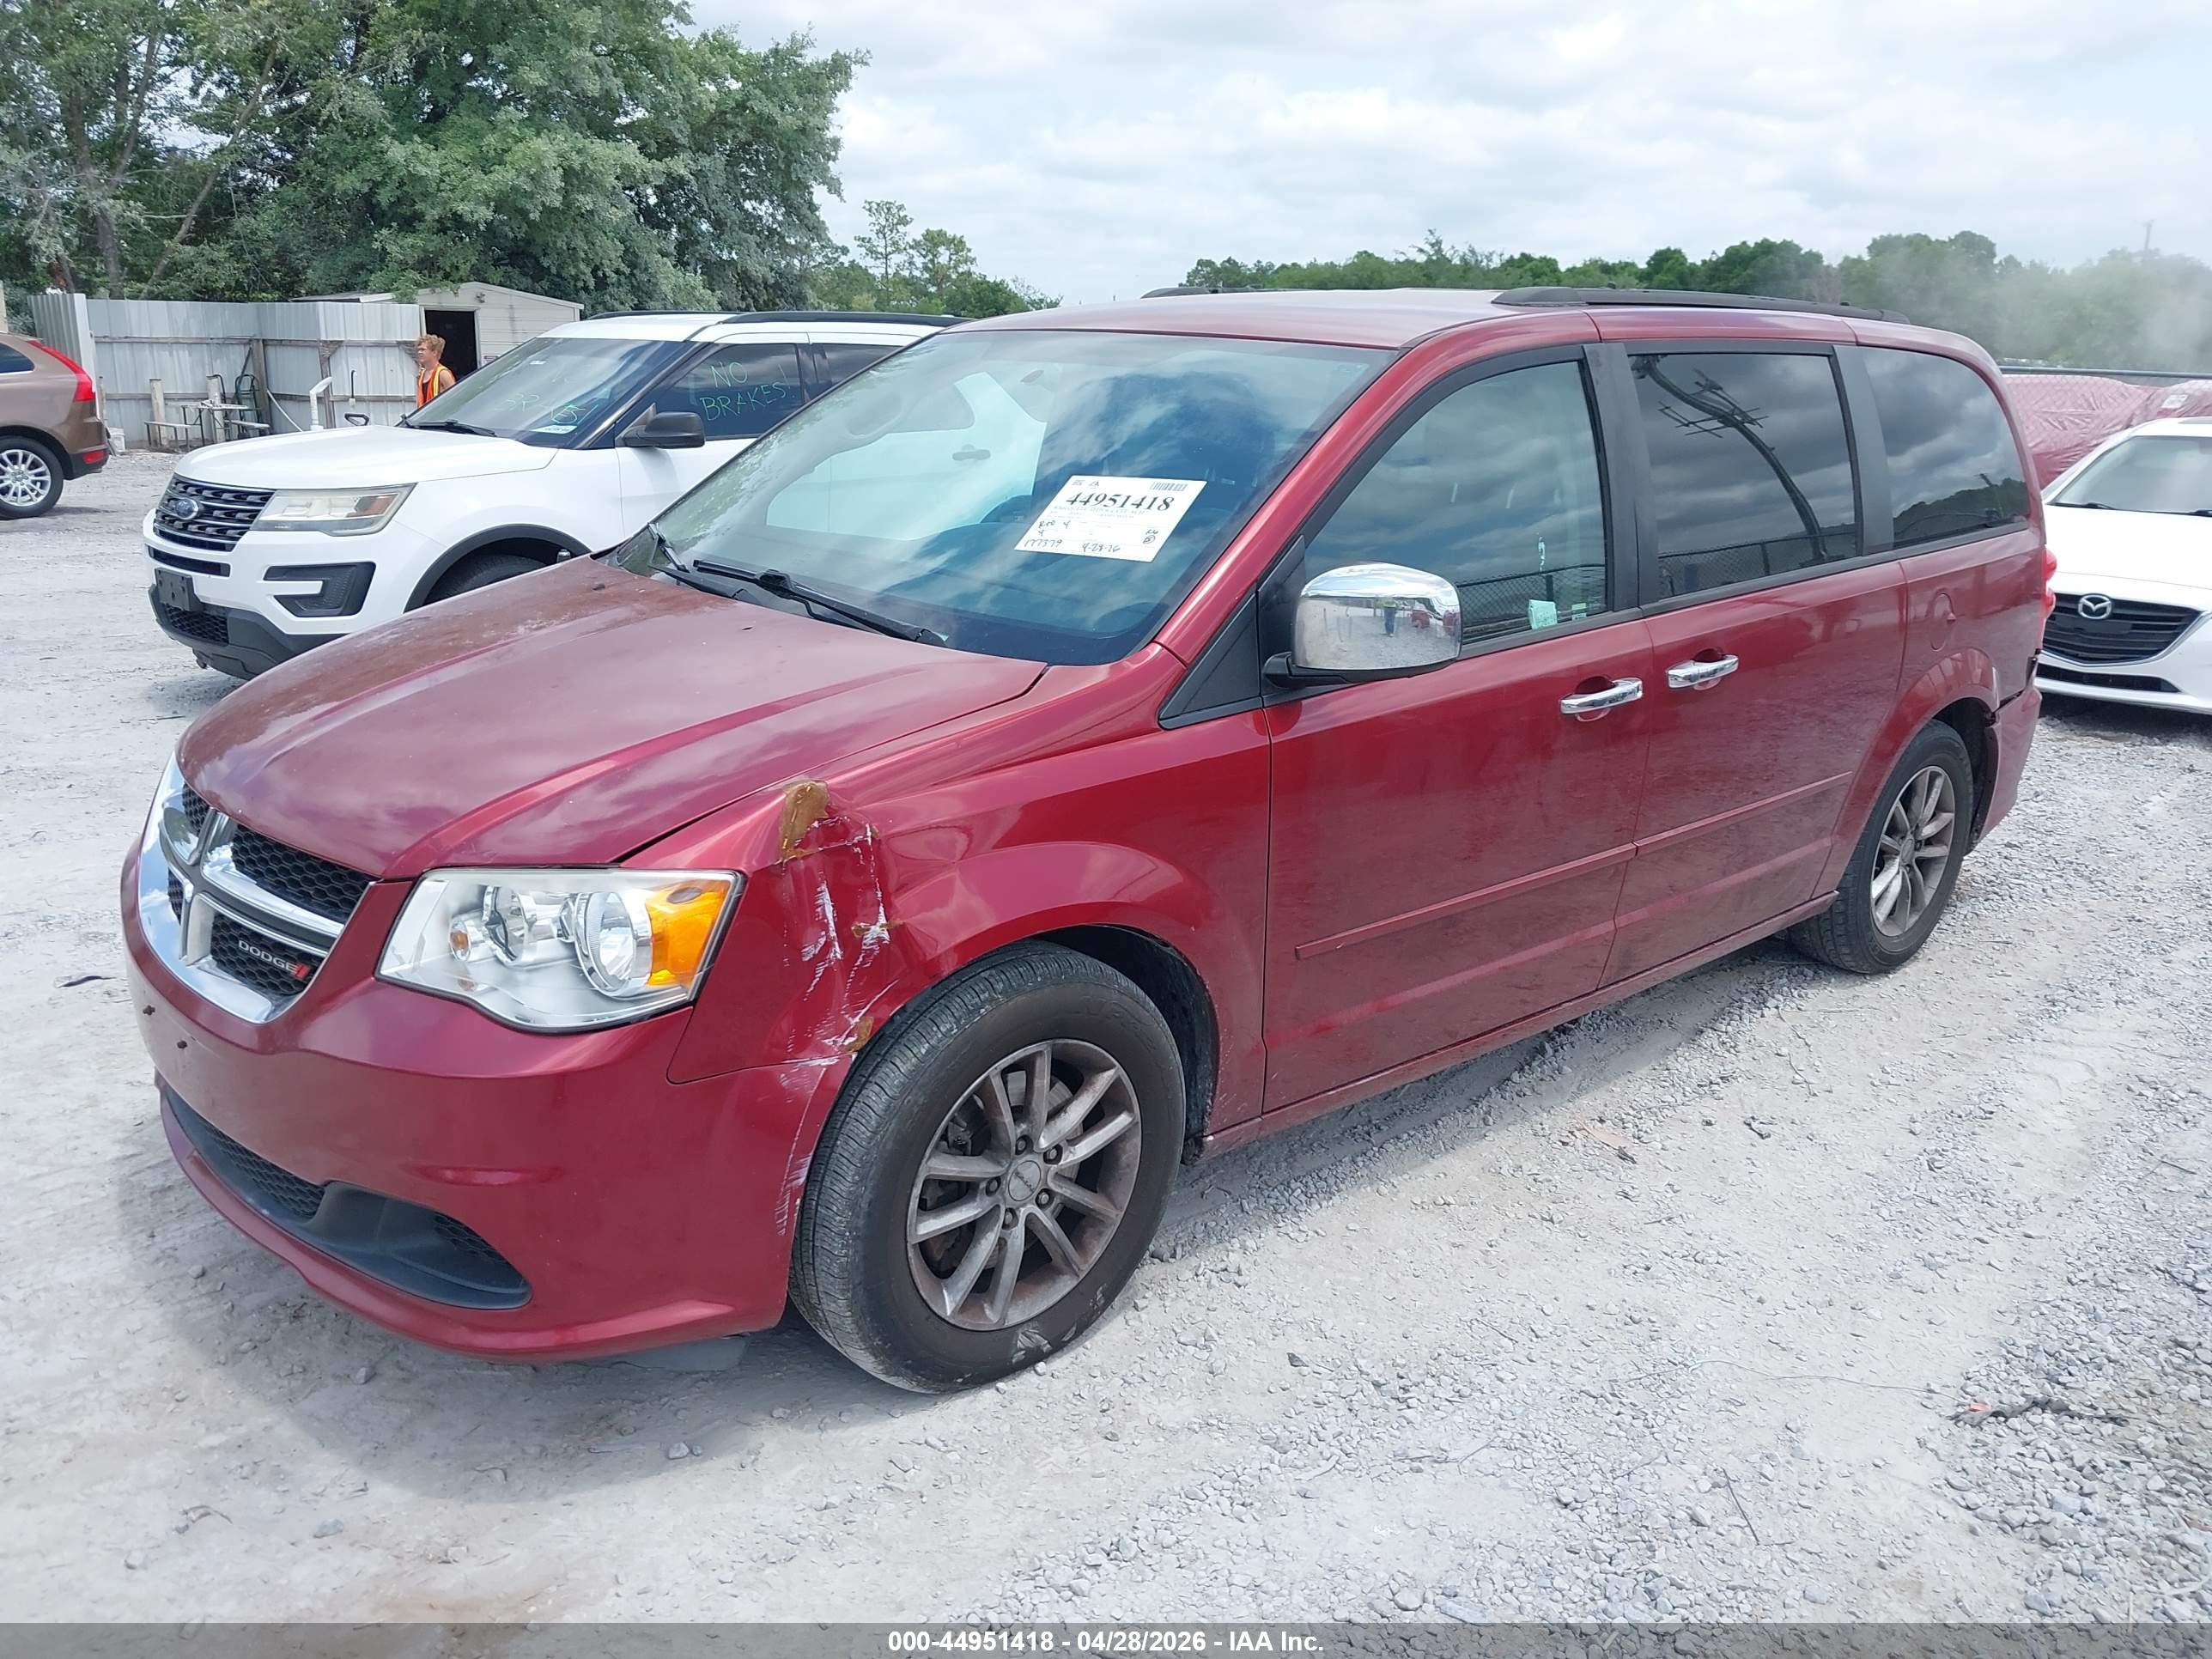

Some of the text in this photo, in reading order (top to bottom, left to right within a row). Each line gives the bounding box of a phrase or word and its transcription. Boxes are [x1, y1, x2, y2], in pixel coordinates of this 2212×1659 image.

[711, 362, 748, 387] NO
[699, 363, 796, 421] BRAKES!
[1066, 492, 1175, 511] 44951418
[239, 940, 298, 974] DODGE
